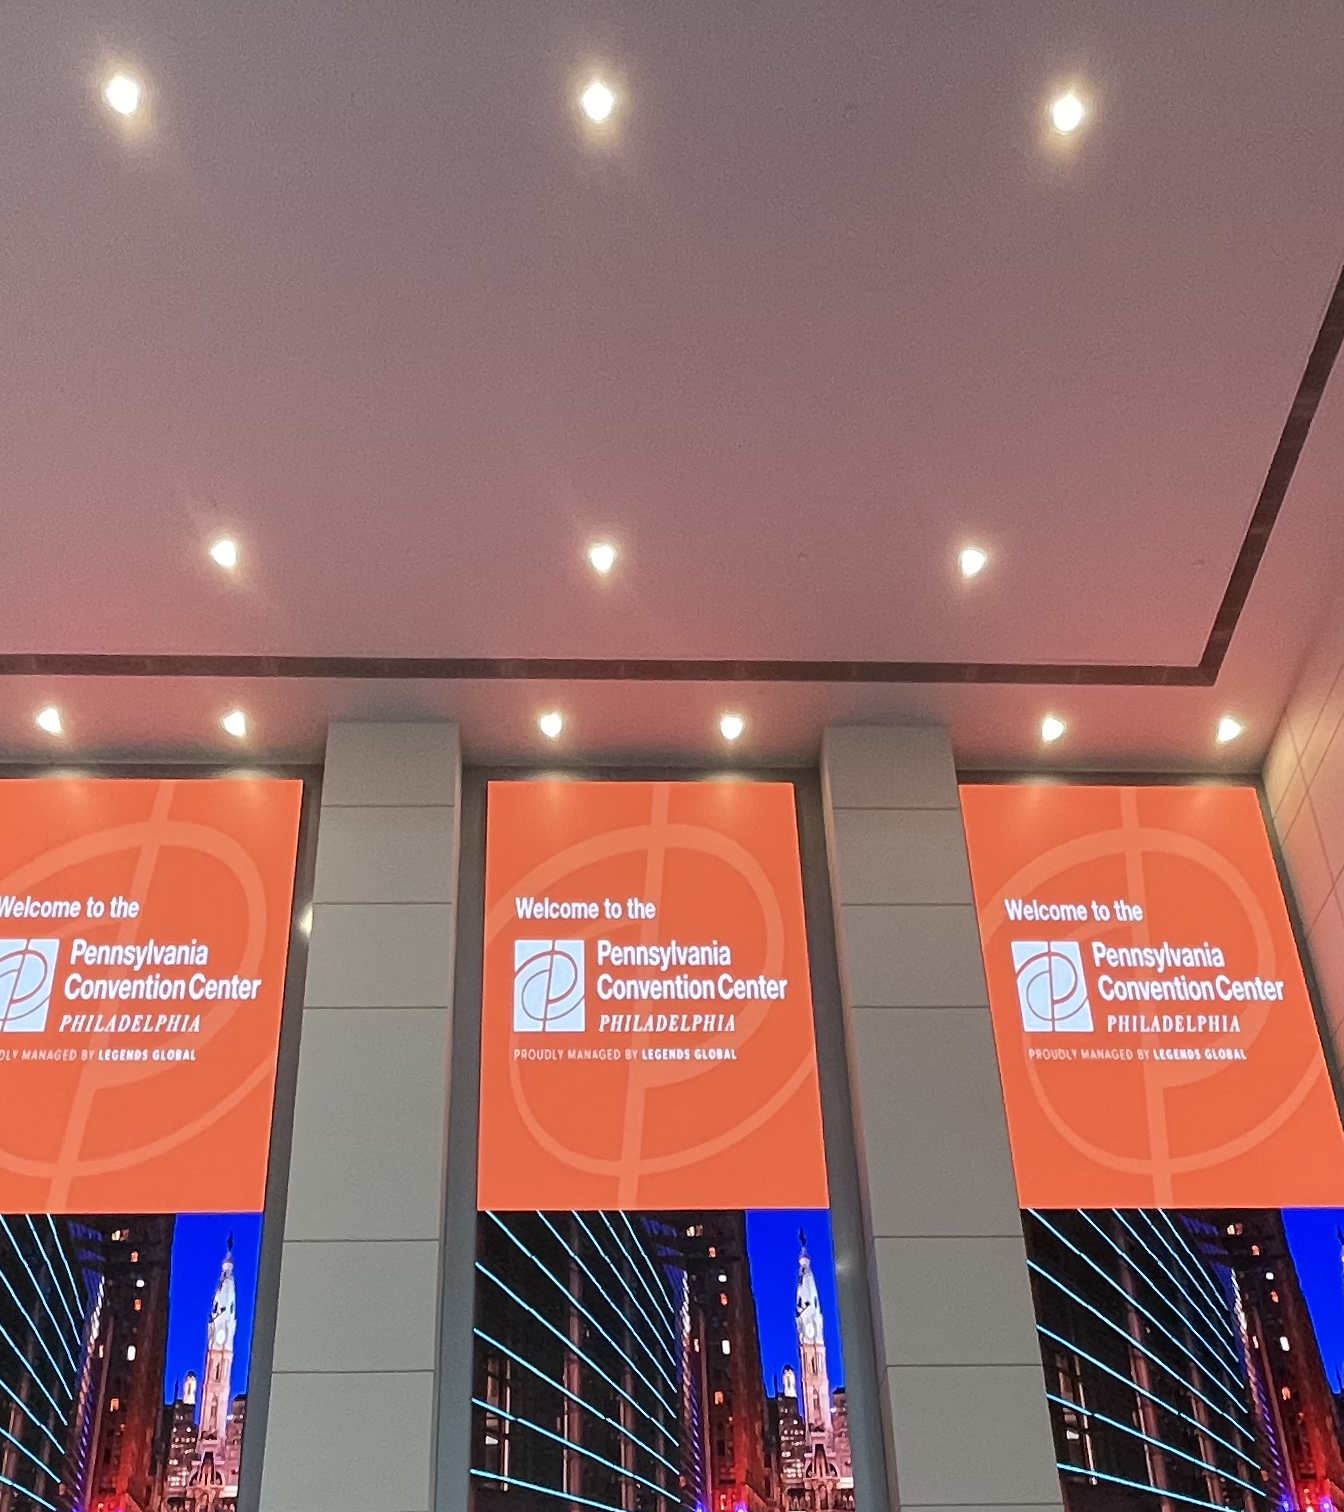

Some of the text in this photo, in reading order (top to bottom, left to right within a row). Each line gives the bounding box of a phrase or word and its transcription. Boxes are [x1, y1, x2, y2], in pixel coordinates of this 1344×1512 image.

[87, 897, 105, 918] to
[109, 896, 140, 918] the
[515, 897, 656, 919] Welcome to the
[1004, 899, 1143, 921] Welcome to the
[70, 938, 208, 971] Pennsylvania
[597, 940, 731, 971] Pennsylvania
[1092, 941, 1225, 973] Pennsylvania
[64, 973, 262, 1000] Convention Center
[597, 974, 787, 1000] Convention Center
[1098, 975, 1284, 1001] Convention Center
[58, 1014, 200, 1033] PHILADELPHIA
[599, 1014, 736, 1032] PHILADELPHIA
[1107, 1015, 1240, 1032] PHILADELPHIA
[22, 1050, 77, 1061] MANAGED
[82, 1050, 95, 1061] BY
[98, 1050, 148, 1061] LEGENDS
[152, 1050, 196, 1061] GLOBAL
[514, 1049, 737, 1060] PROUDLY MANAGED BY LEGENDS GLOBAL
[1029, 1049, 1247, 1060] PROUDLY MANAGED BY LEGENDS GLOBAL
